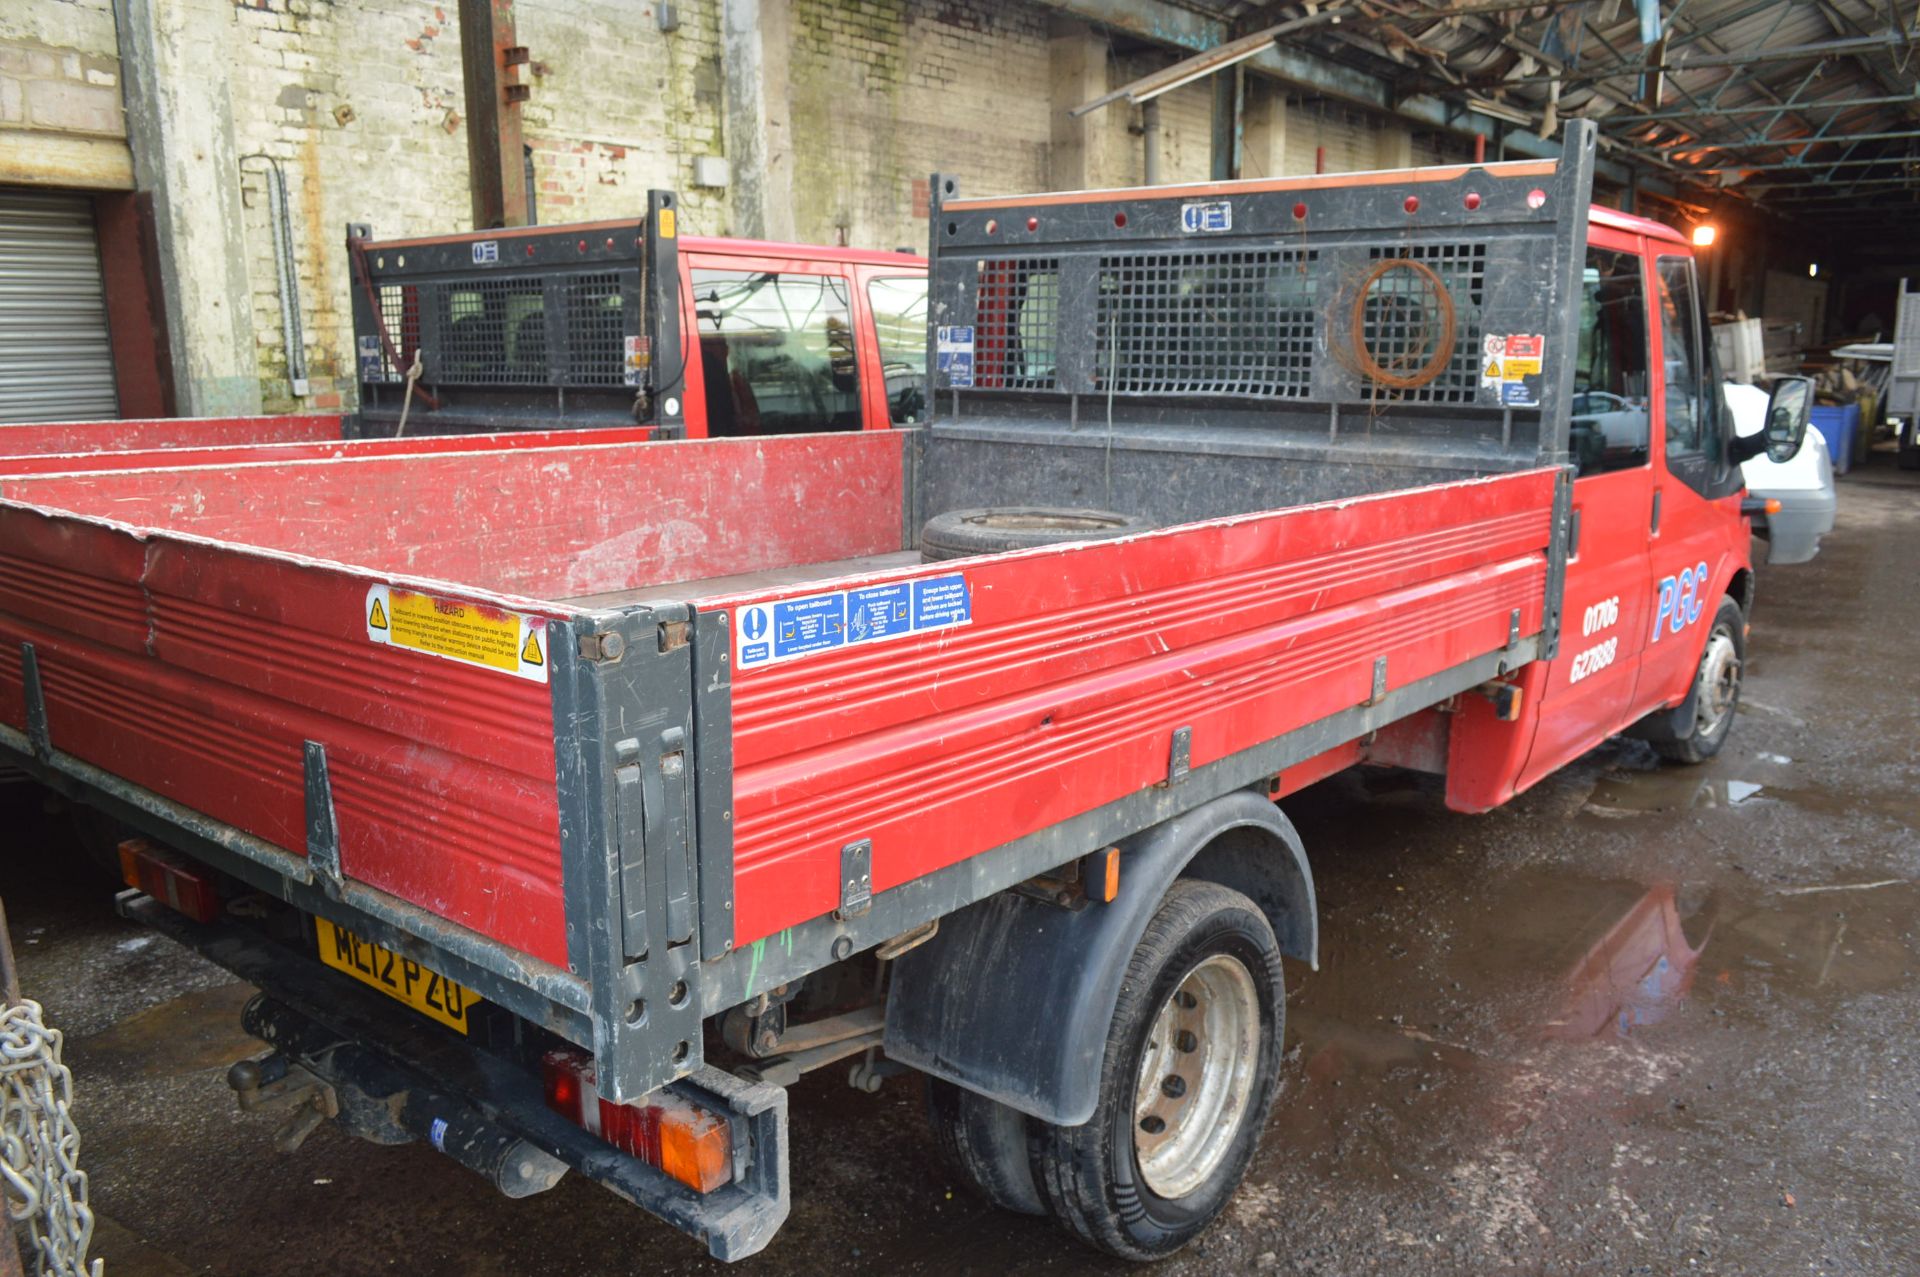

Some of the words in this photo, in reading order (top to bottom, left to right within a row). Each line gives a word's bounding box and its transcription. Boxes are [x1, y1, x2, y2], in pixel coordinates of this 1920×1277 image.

[880, 588, 900, 597] tailboard
[944, 592, 963, 600] tailboard
[809, 599, 832, 608] tailboard
[1651, 561, 1707, 643] PGC
[394, 608, 411, 617] Tailboard
[434, 604, 464, 618] HAZARD
[1583, 596, 1619, 636] 01706
